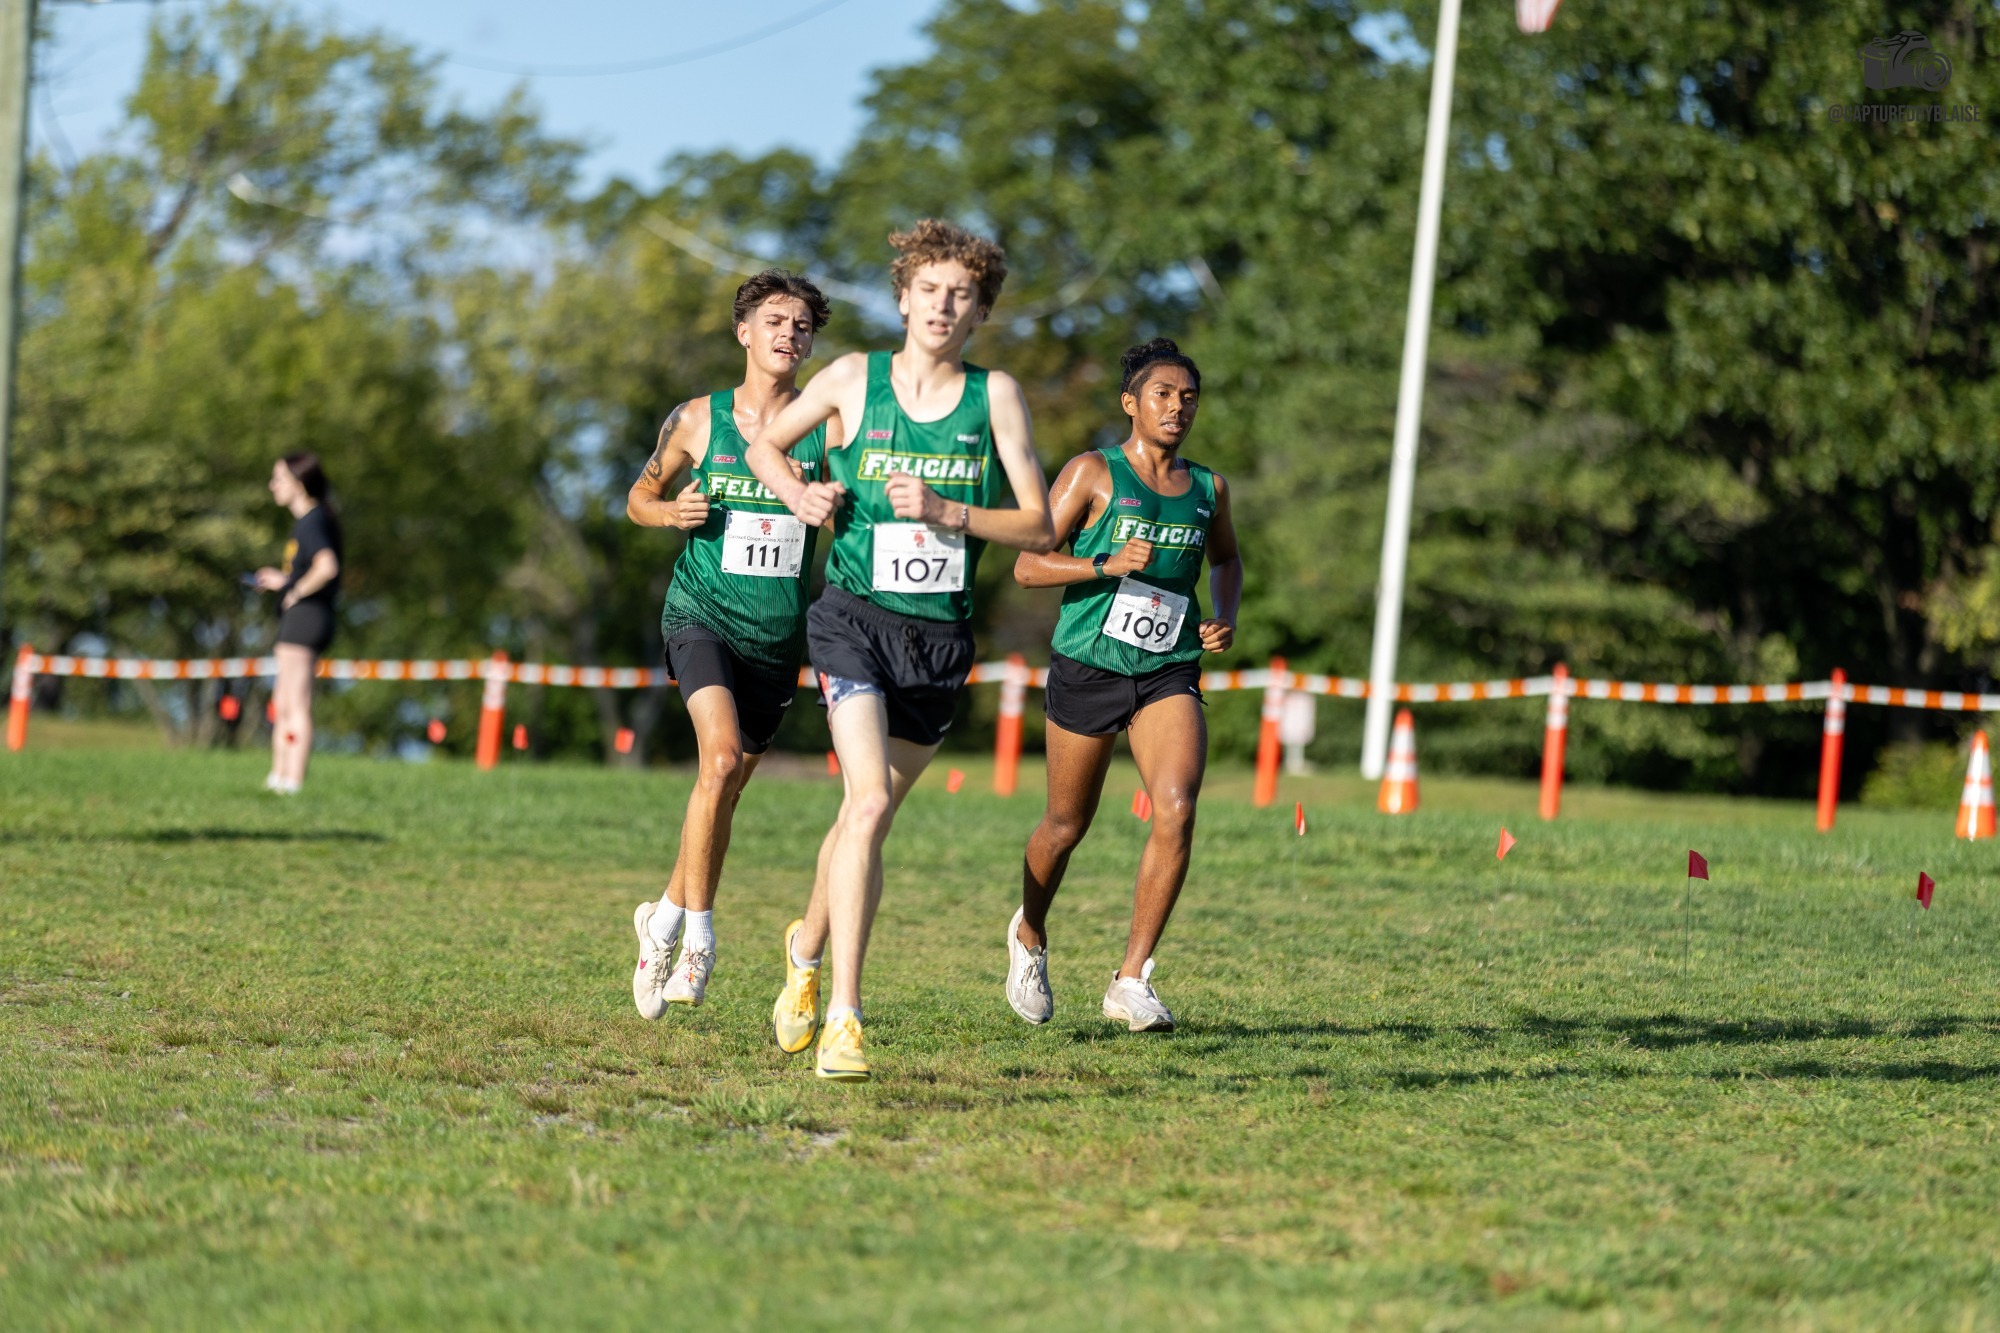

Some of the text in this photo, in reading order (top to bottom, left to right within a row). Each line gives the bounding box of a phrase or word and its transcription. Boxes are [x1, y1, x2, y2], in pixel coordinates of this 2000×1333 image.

[713, 455, 737, 464] CACC
[864, 453, 981, 479] FELICIAN
[710, 476, 777, 499] FELIC
[1120, 498, 1141, 507] CACC
[1117, 518, 1204, 546] FELICIA
[746, 543, 781, 568] 111
[892, 557, 949, 583] 107
[1122, 611, 1169, 643] 109
